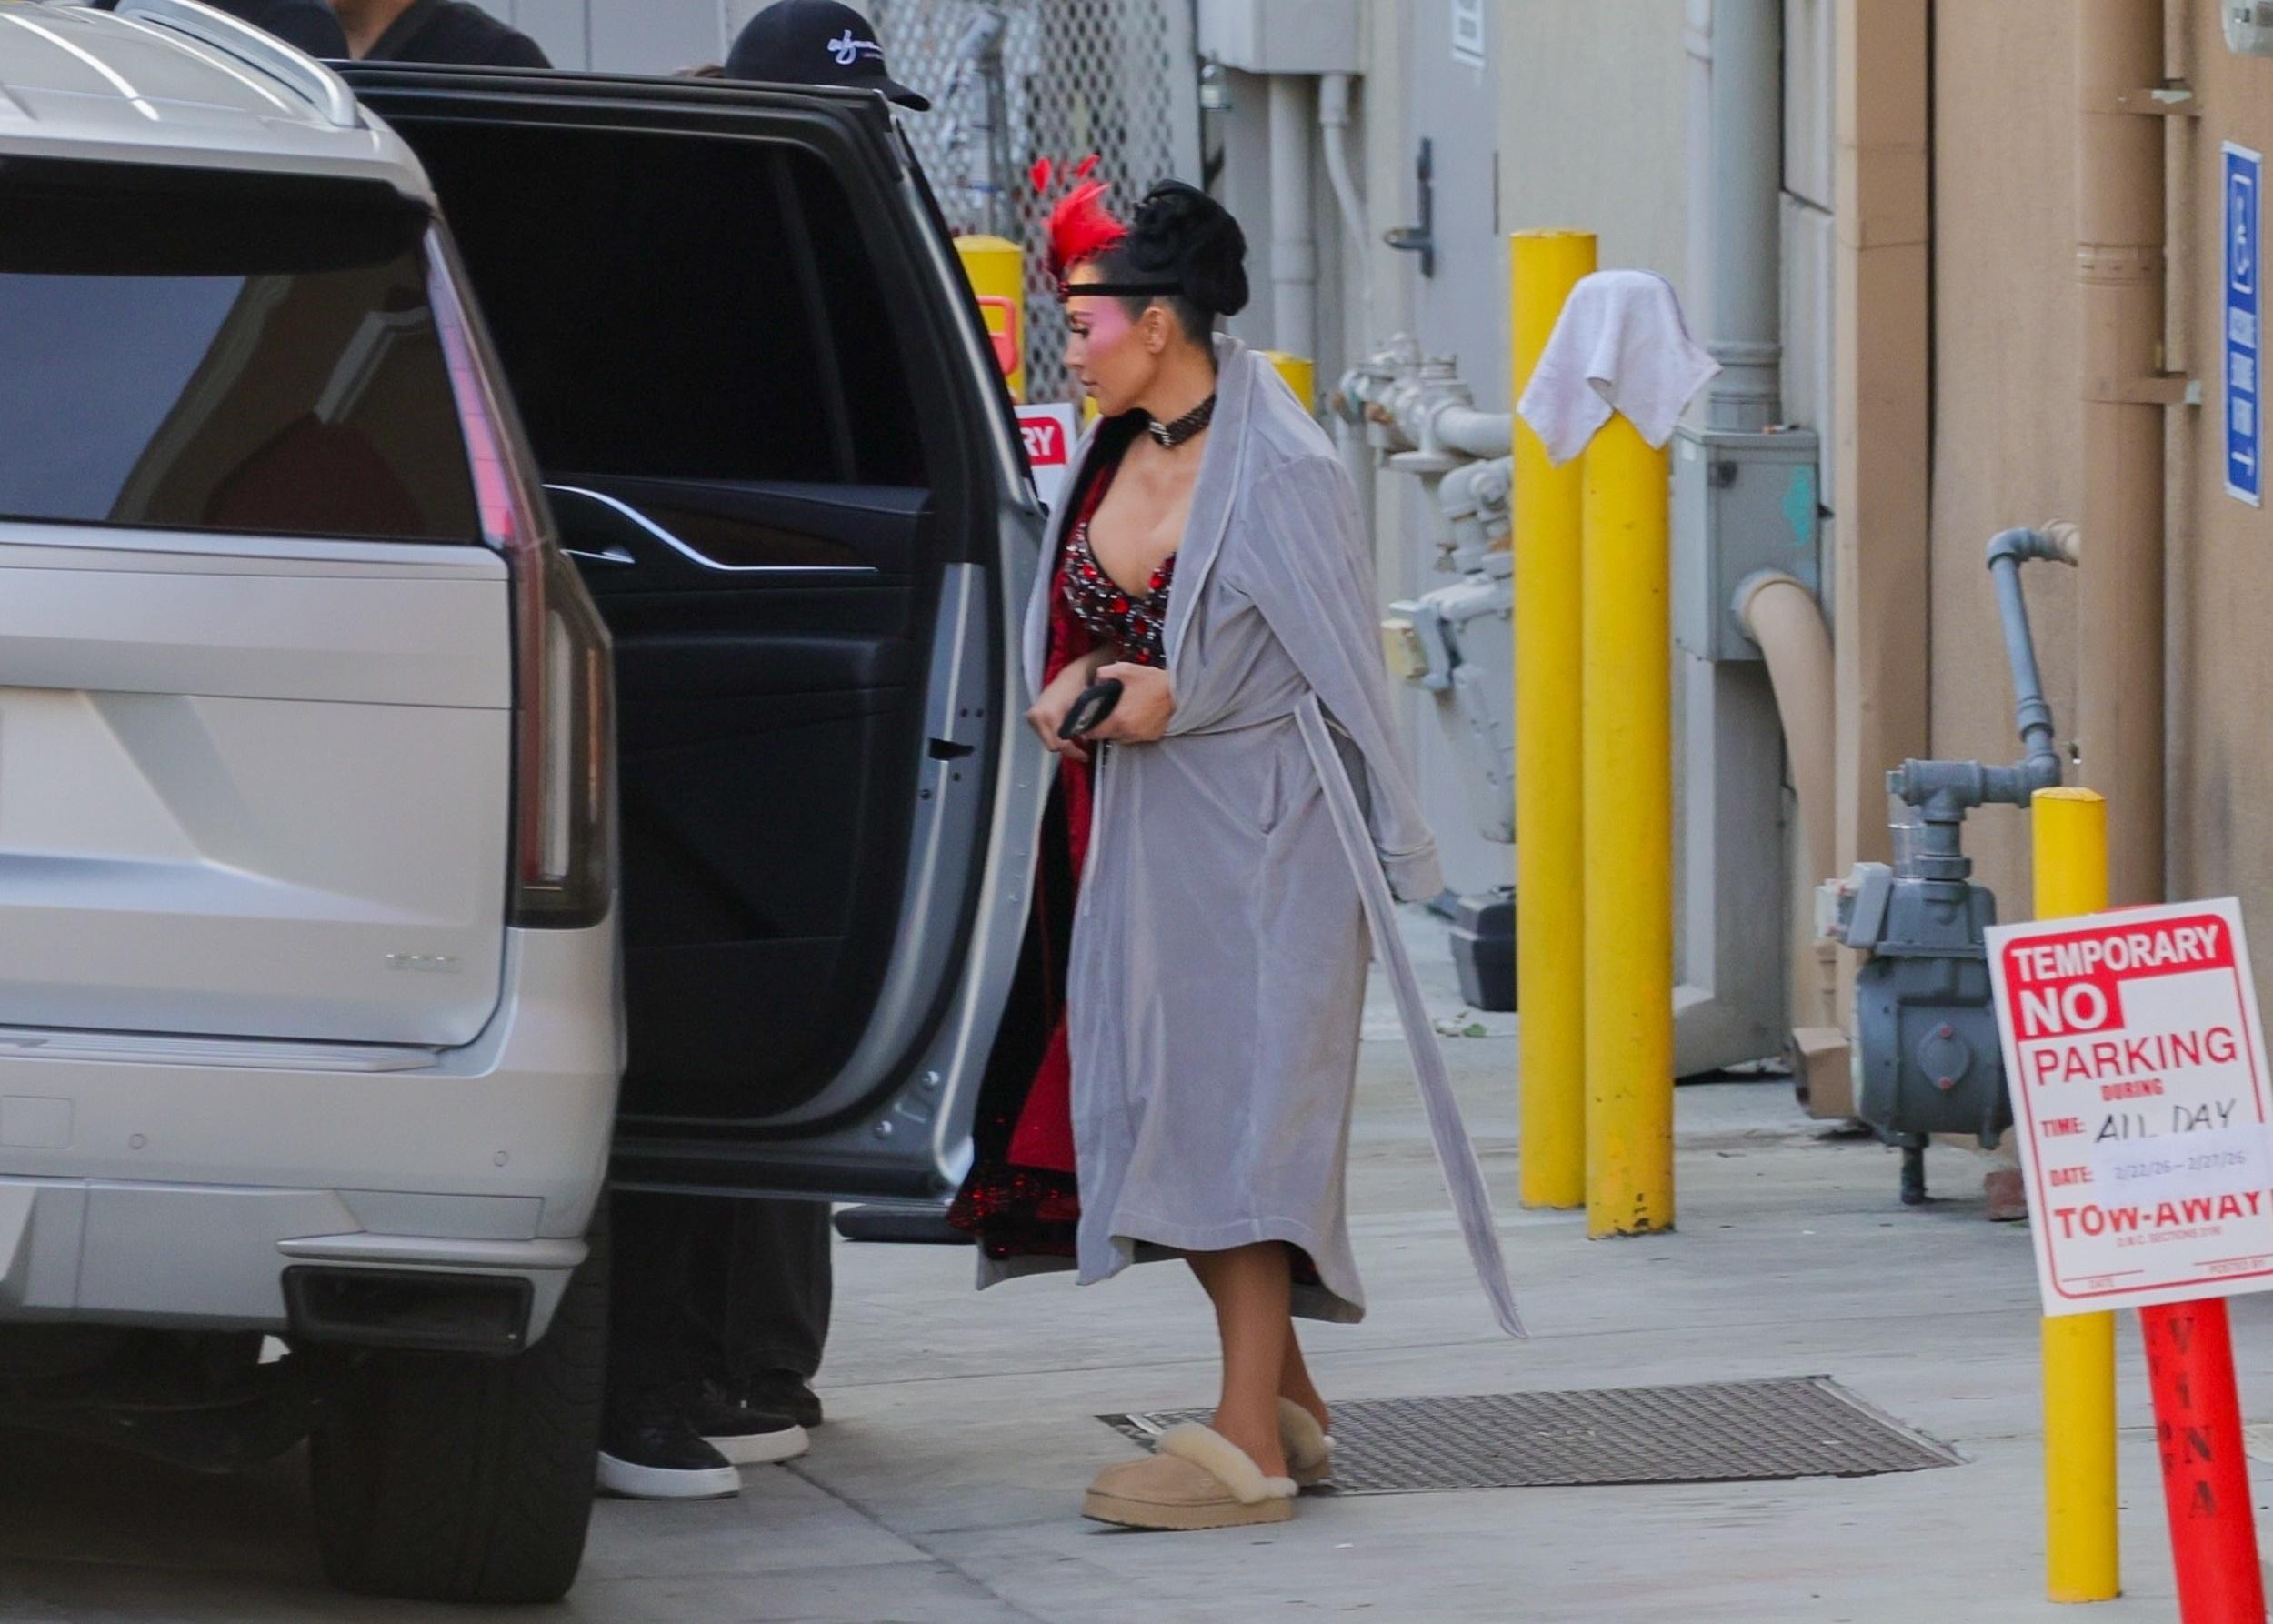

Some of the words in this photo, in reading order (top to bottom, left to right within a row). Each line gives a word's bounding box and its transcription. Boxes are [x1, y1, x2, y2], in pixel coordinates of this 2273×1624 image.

[2011, 924, 2218, 982] TEMPORARY
[2018, 983, 2108, 1037] NO
[2033, 1026, 2238, 1086] PARKING
[2041, 1117, 2086, 1138] TIME:
[2173, 1098, 2237, 1134] DAY
